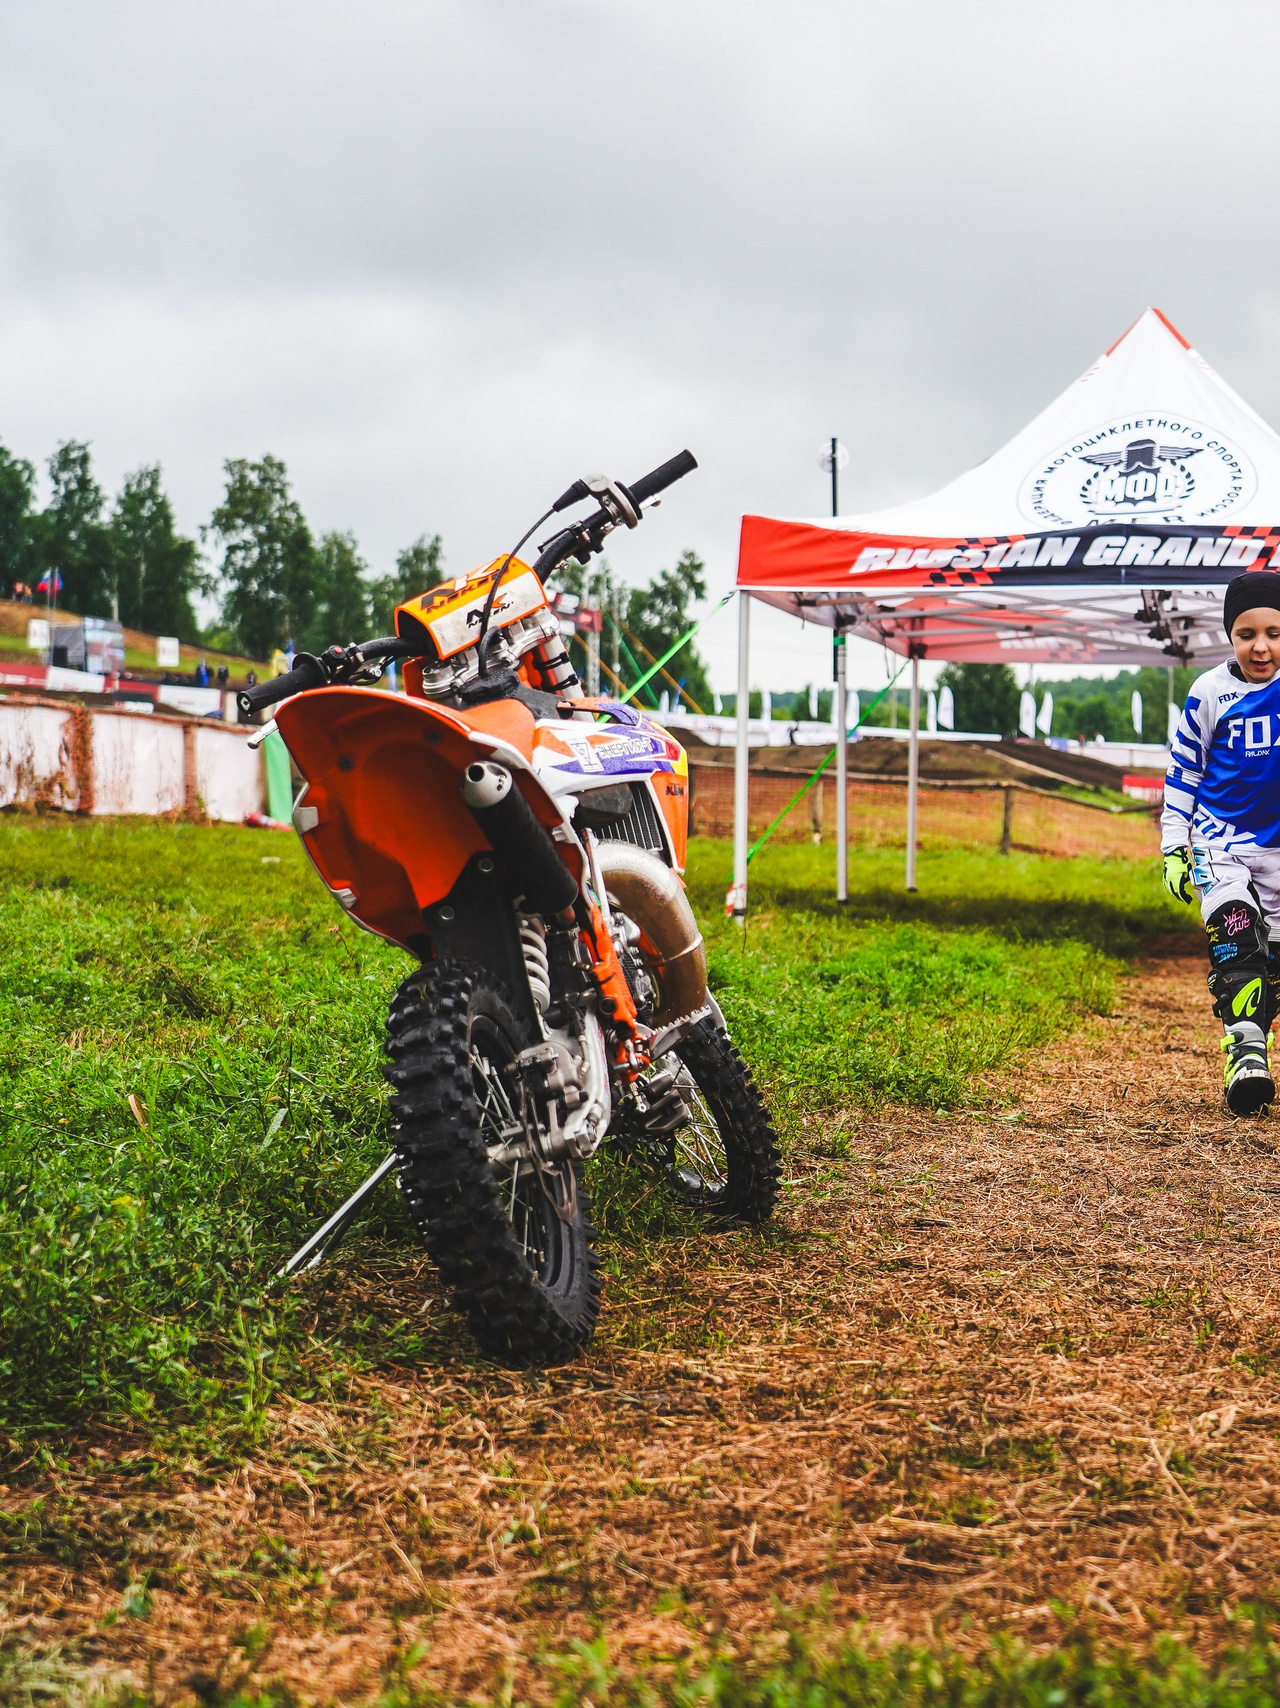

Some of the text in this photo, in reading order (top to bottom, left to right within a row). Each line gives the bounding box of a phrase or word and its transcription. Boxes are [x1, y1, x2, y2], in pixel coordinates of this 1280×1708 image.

[1043, 418, 1203, 475] МОТОЦИКЛЕТНОГО
[1206, 440, 1243, 481] СПОРТА
[1198, 486, 1242, 517] РОССИИ
[1082, 535, 1266, 568] GRAND
[1218, 691, 1239, 704] FOX
[666, 783, 684, 797] KTM
